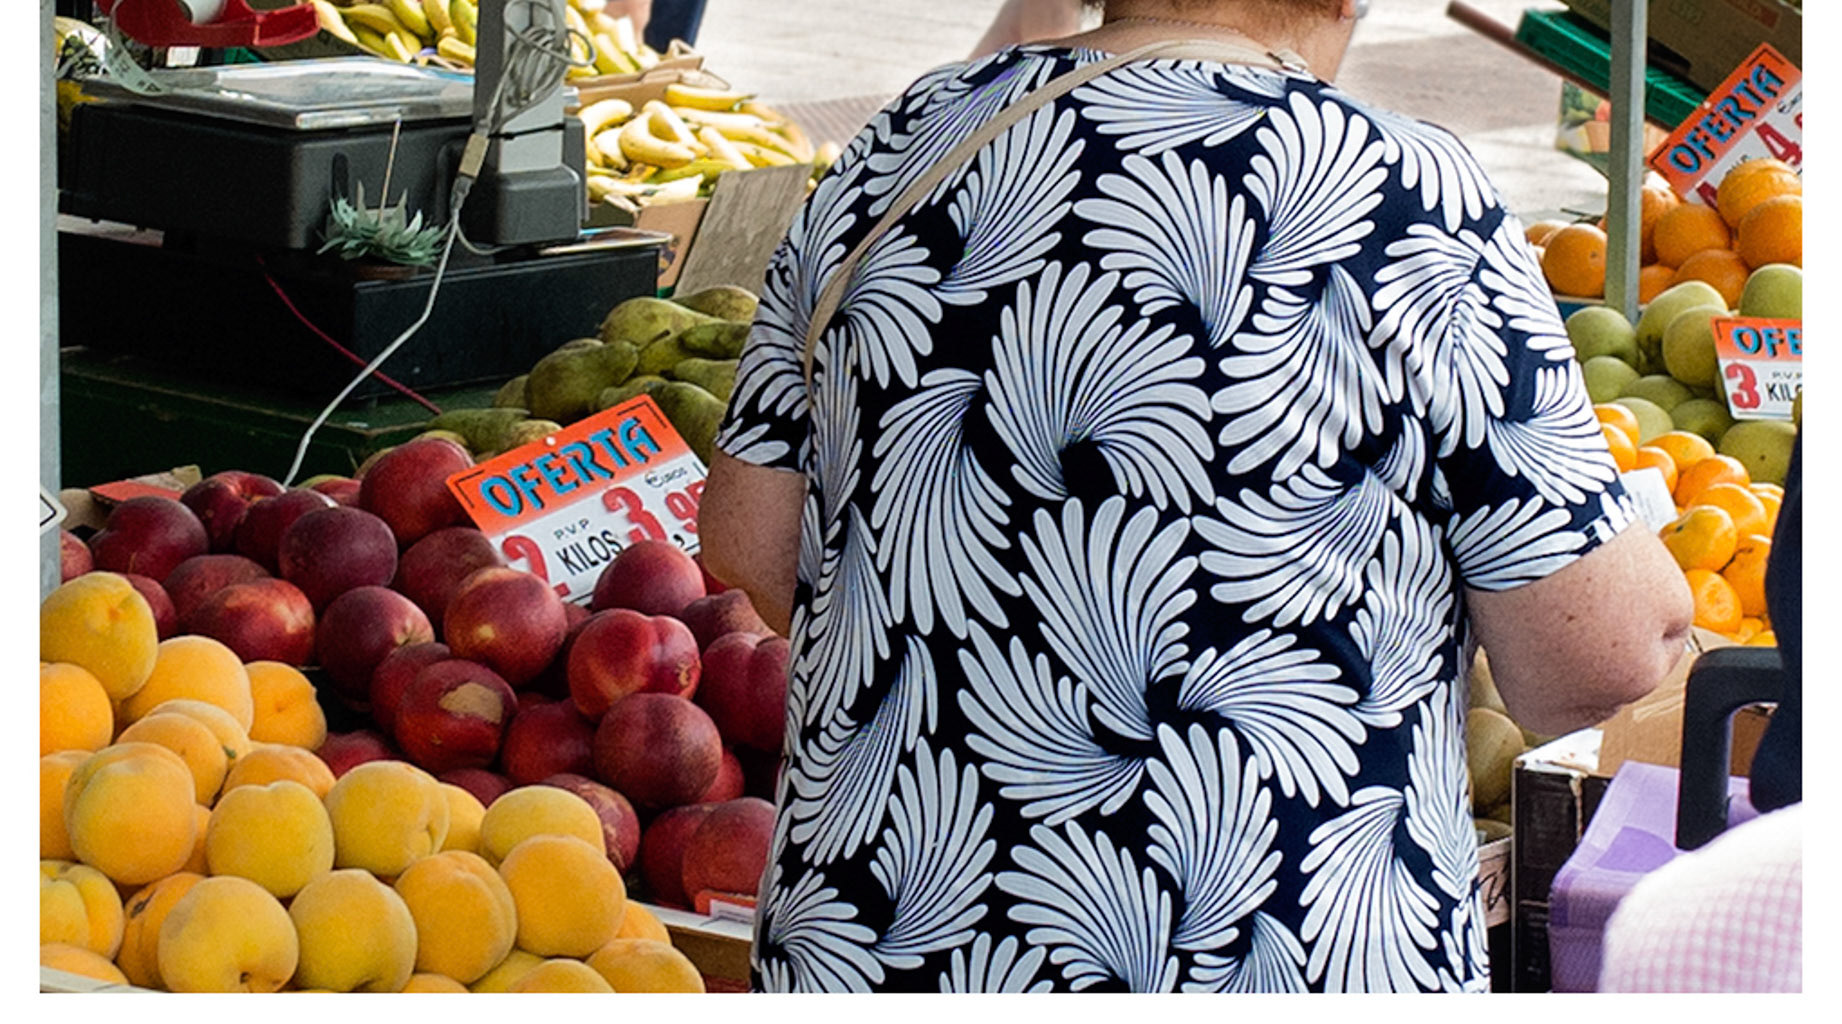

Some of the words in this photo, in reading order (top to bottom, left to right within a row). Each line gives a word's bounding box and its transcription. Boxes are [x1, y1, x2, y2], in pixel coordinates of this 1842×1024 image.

[1669, 64, 1785, 174] OFERTA
[1755, 112, 1802, 166] 4
[1725, 362, 1761, 410] 3
[480, 417, 662, 517] OFERTA
[556, 529, 624, 576] KILOS
